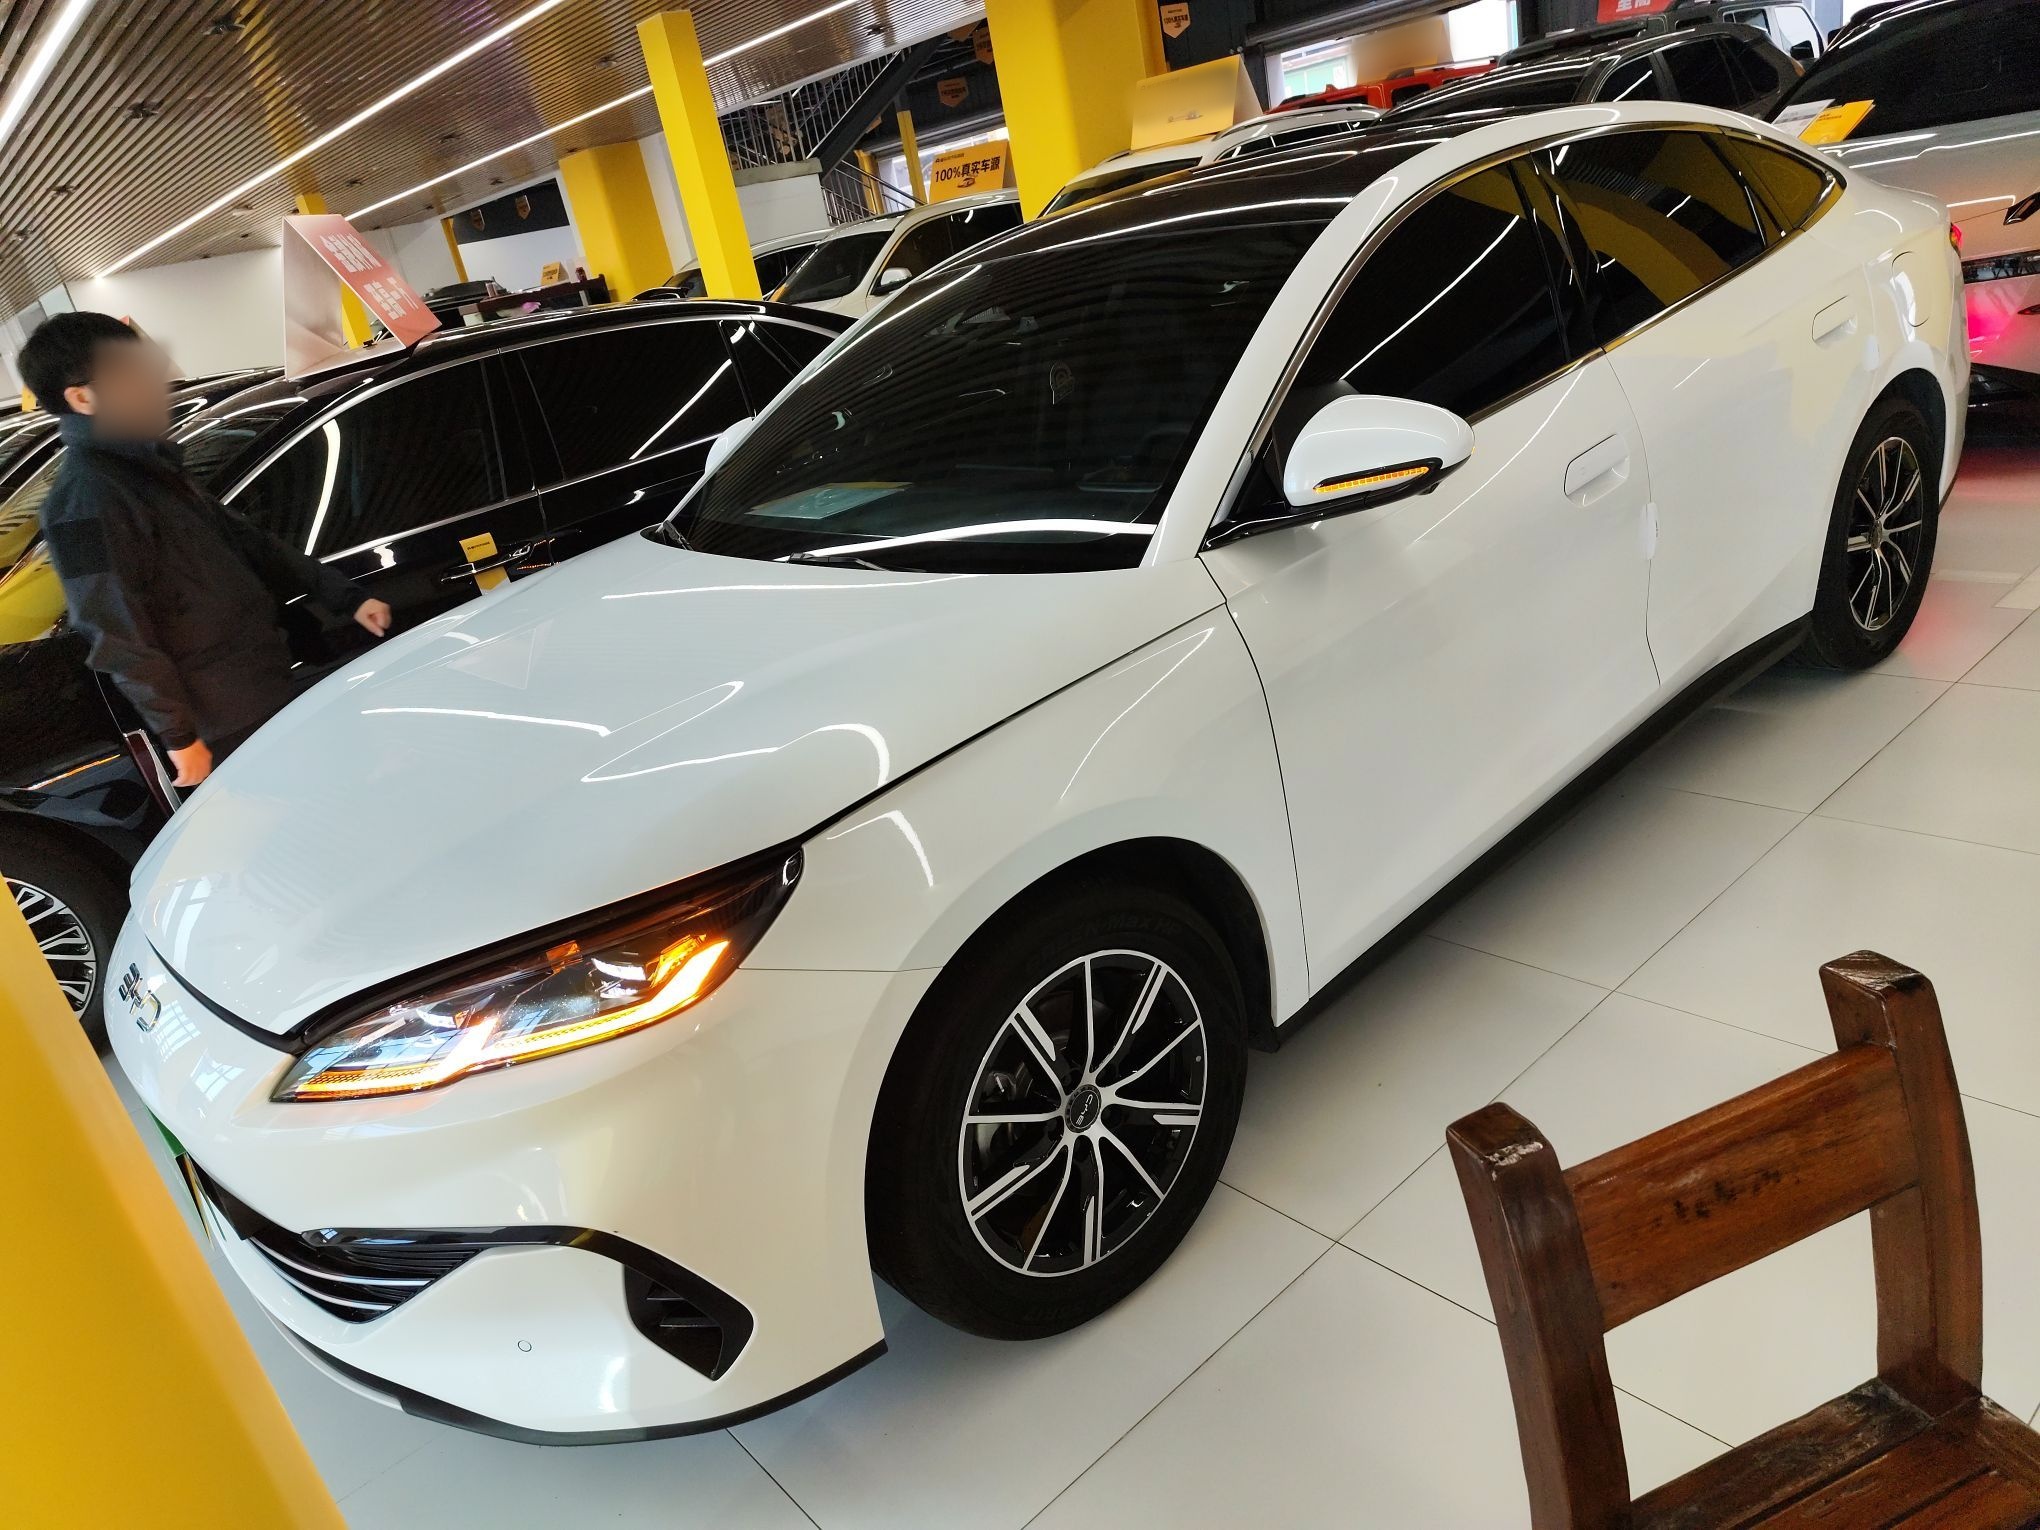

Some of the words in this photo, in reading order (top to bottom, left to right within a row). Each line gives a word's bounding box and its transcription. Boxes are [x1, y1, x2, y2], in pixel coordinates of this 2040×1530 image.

[935, 156, 1001, 183] 100%真实车源
[363, 276, 419, 321] 至高一万
[1075, 1093, 1094, 1126] BYD
